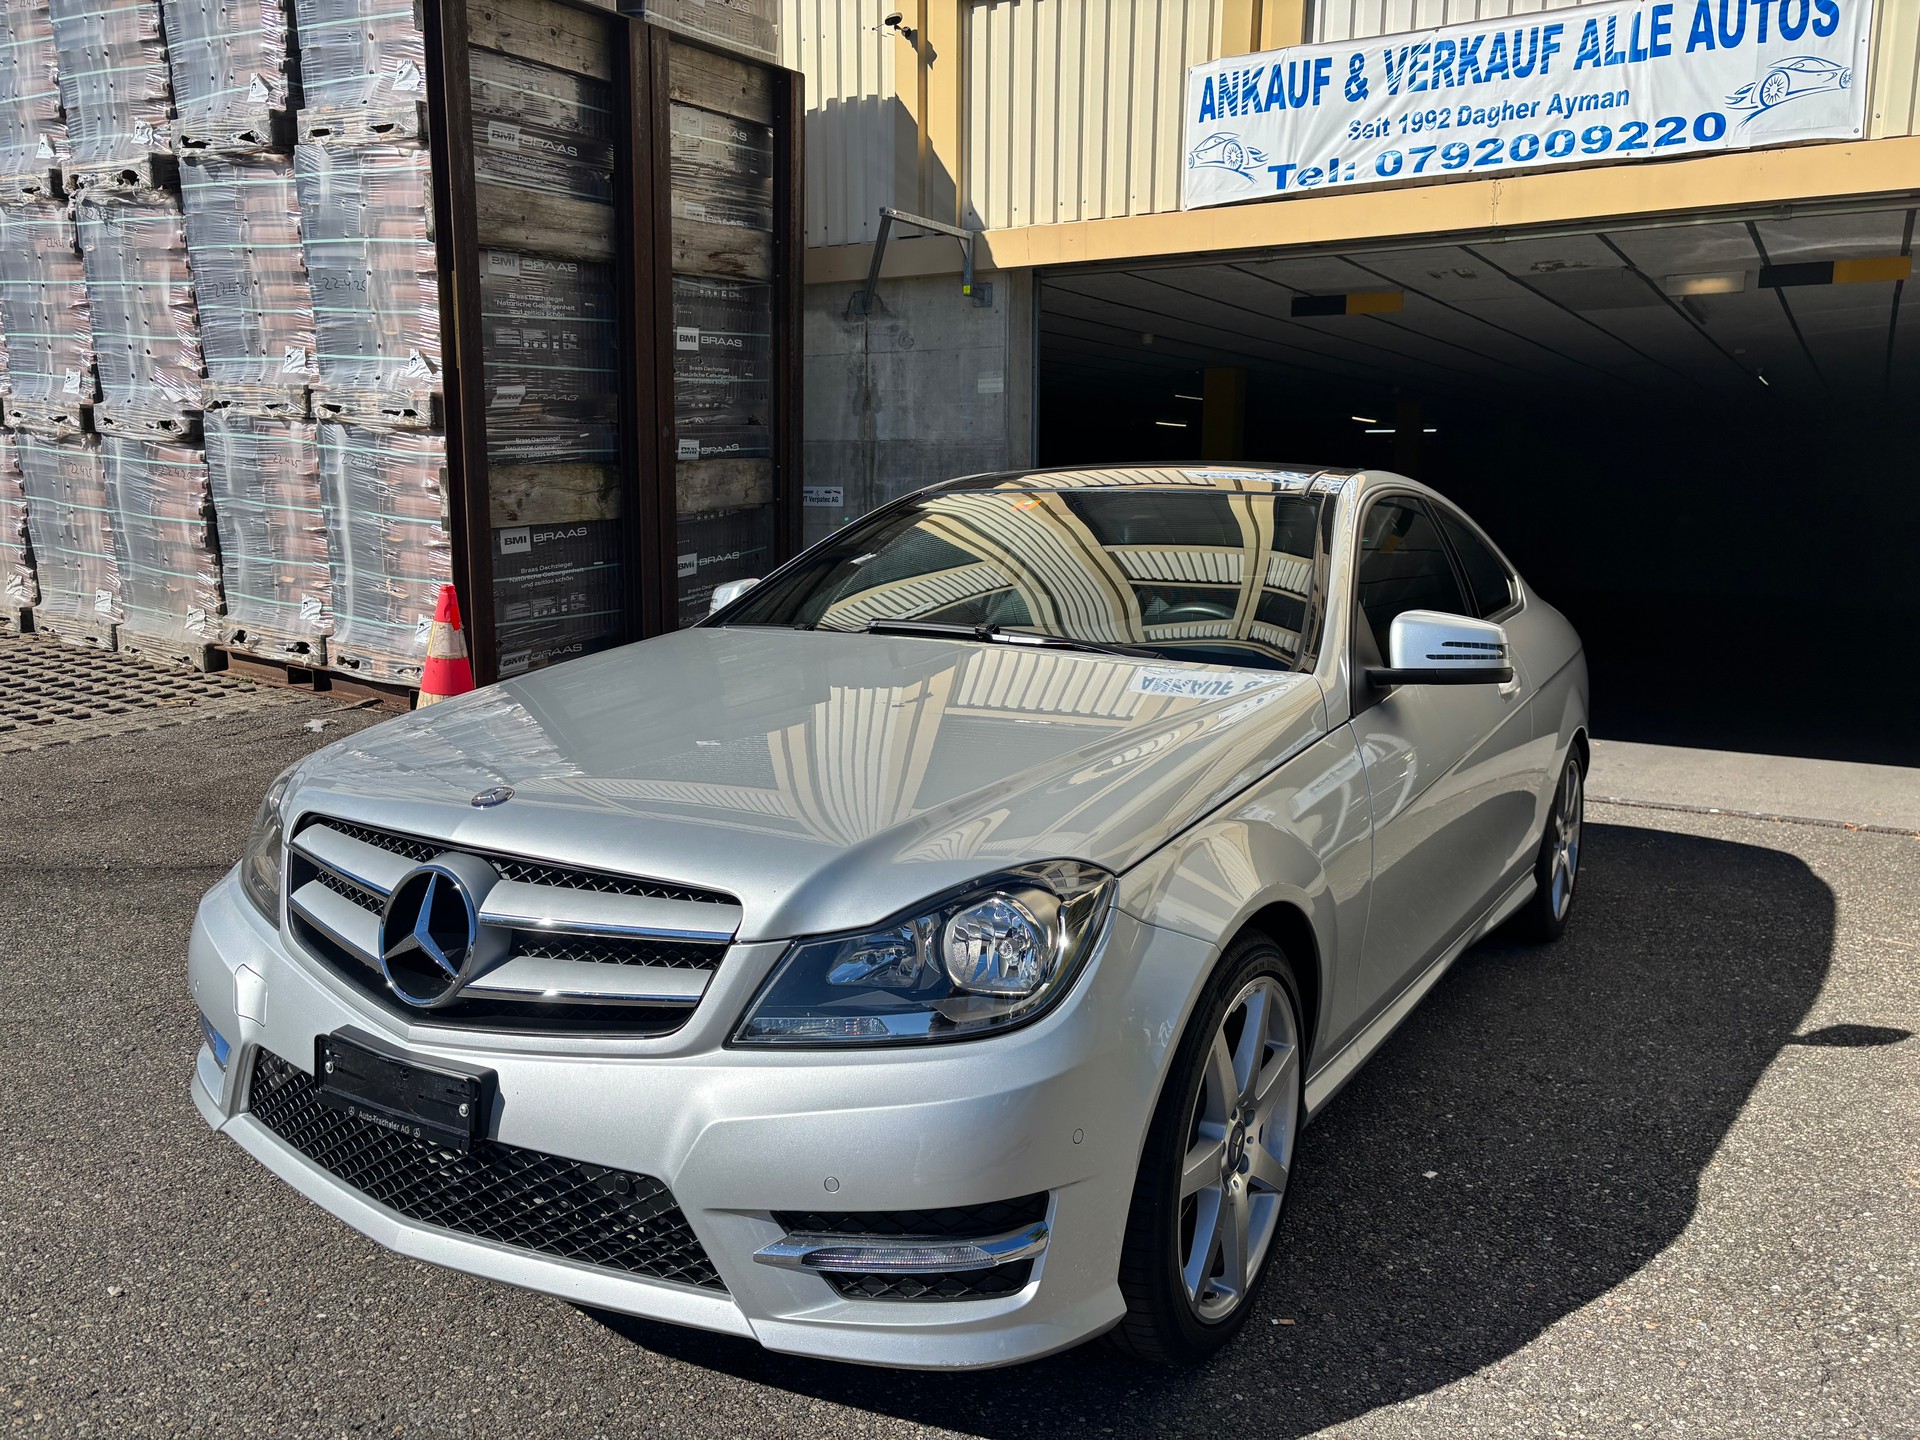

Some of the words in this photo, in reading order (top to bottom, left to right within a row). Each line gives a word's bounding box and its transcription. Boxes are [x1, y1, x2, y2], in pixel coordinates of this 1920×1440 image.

[1198, 57, 1333, 123] ANKAUF
[1344, 52, 1369, 102] &
[1384, 23, 1564, 96] VERKAUF
[1573, 3, 1674, 70] ALLE
[1685, 0, 1840, 53] AUTOS
[1348, 117, 1390, 140] Seit
[1398, 105, 1451, 134] 1992
[1457, 99, 1540, 128] Dagher
[1546, 88, 1630, 120] Ayman
[1267, 157, 1356, 190] Tel:
[1375, 111, 1727, 177] 0792009220
[522, 259, 578, 273] BRAAS
[679, 334, 696, 343] BMI
[701, 336, 742, 347] BRAAS
[701, 444, 740, 455] BRAAS
[504, 536, 527, 546] BMI
[533, 526, 588, 542] BRAAS
[700, 552, 740, 566] BRAAS
[540, 561, 573, 572] Dachziegel
[555, 576, 574, 584] schön
[531, 644, 583, 660] BRAAS
[400, 1124, 410, 1134] AG
